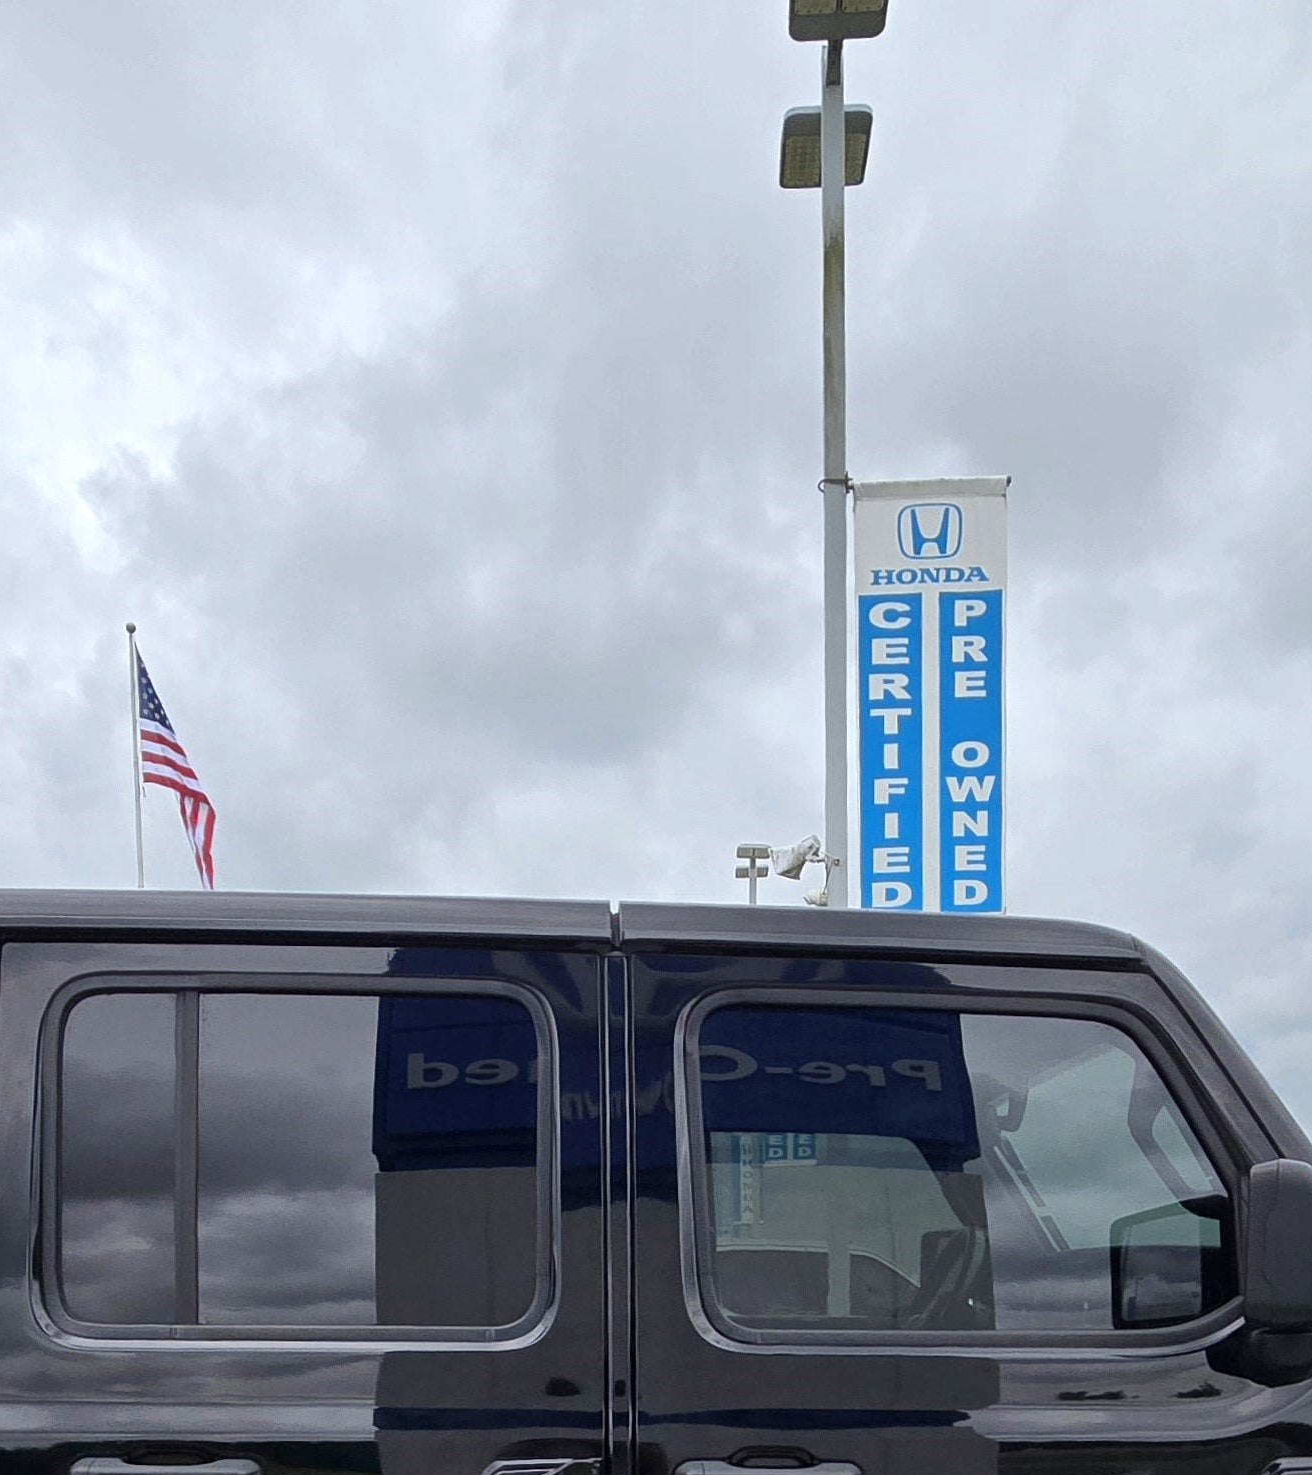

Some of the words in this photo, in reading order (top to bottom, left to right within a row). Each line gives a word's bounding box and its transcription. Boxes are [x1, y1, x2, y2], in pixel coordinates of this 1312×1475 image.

[870, 566, 989, 585] HONDA
[952, 600, 988, 698] PRE
[869, 602, 912, 908] CERTIFIED
[946, 741, 995, 906] OWNED
